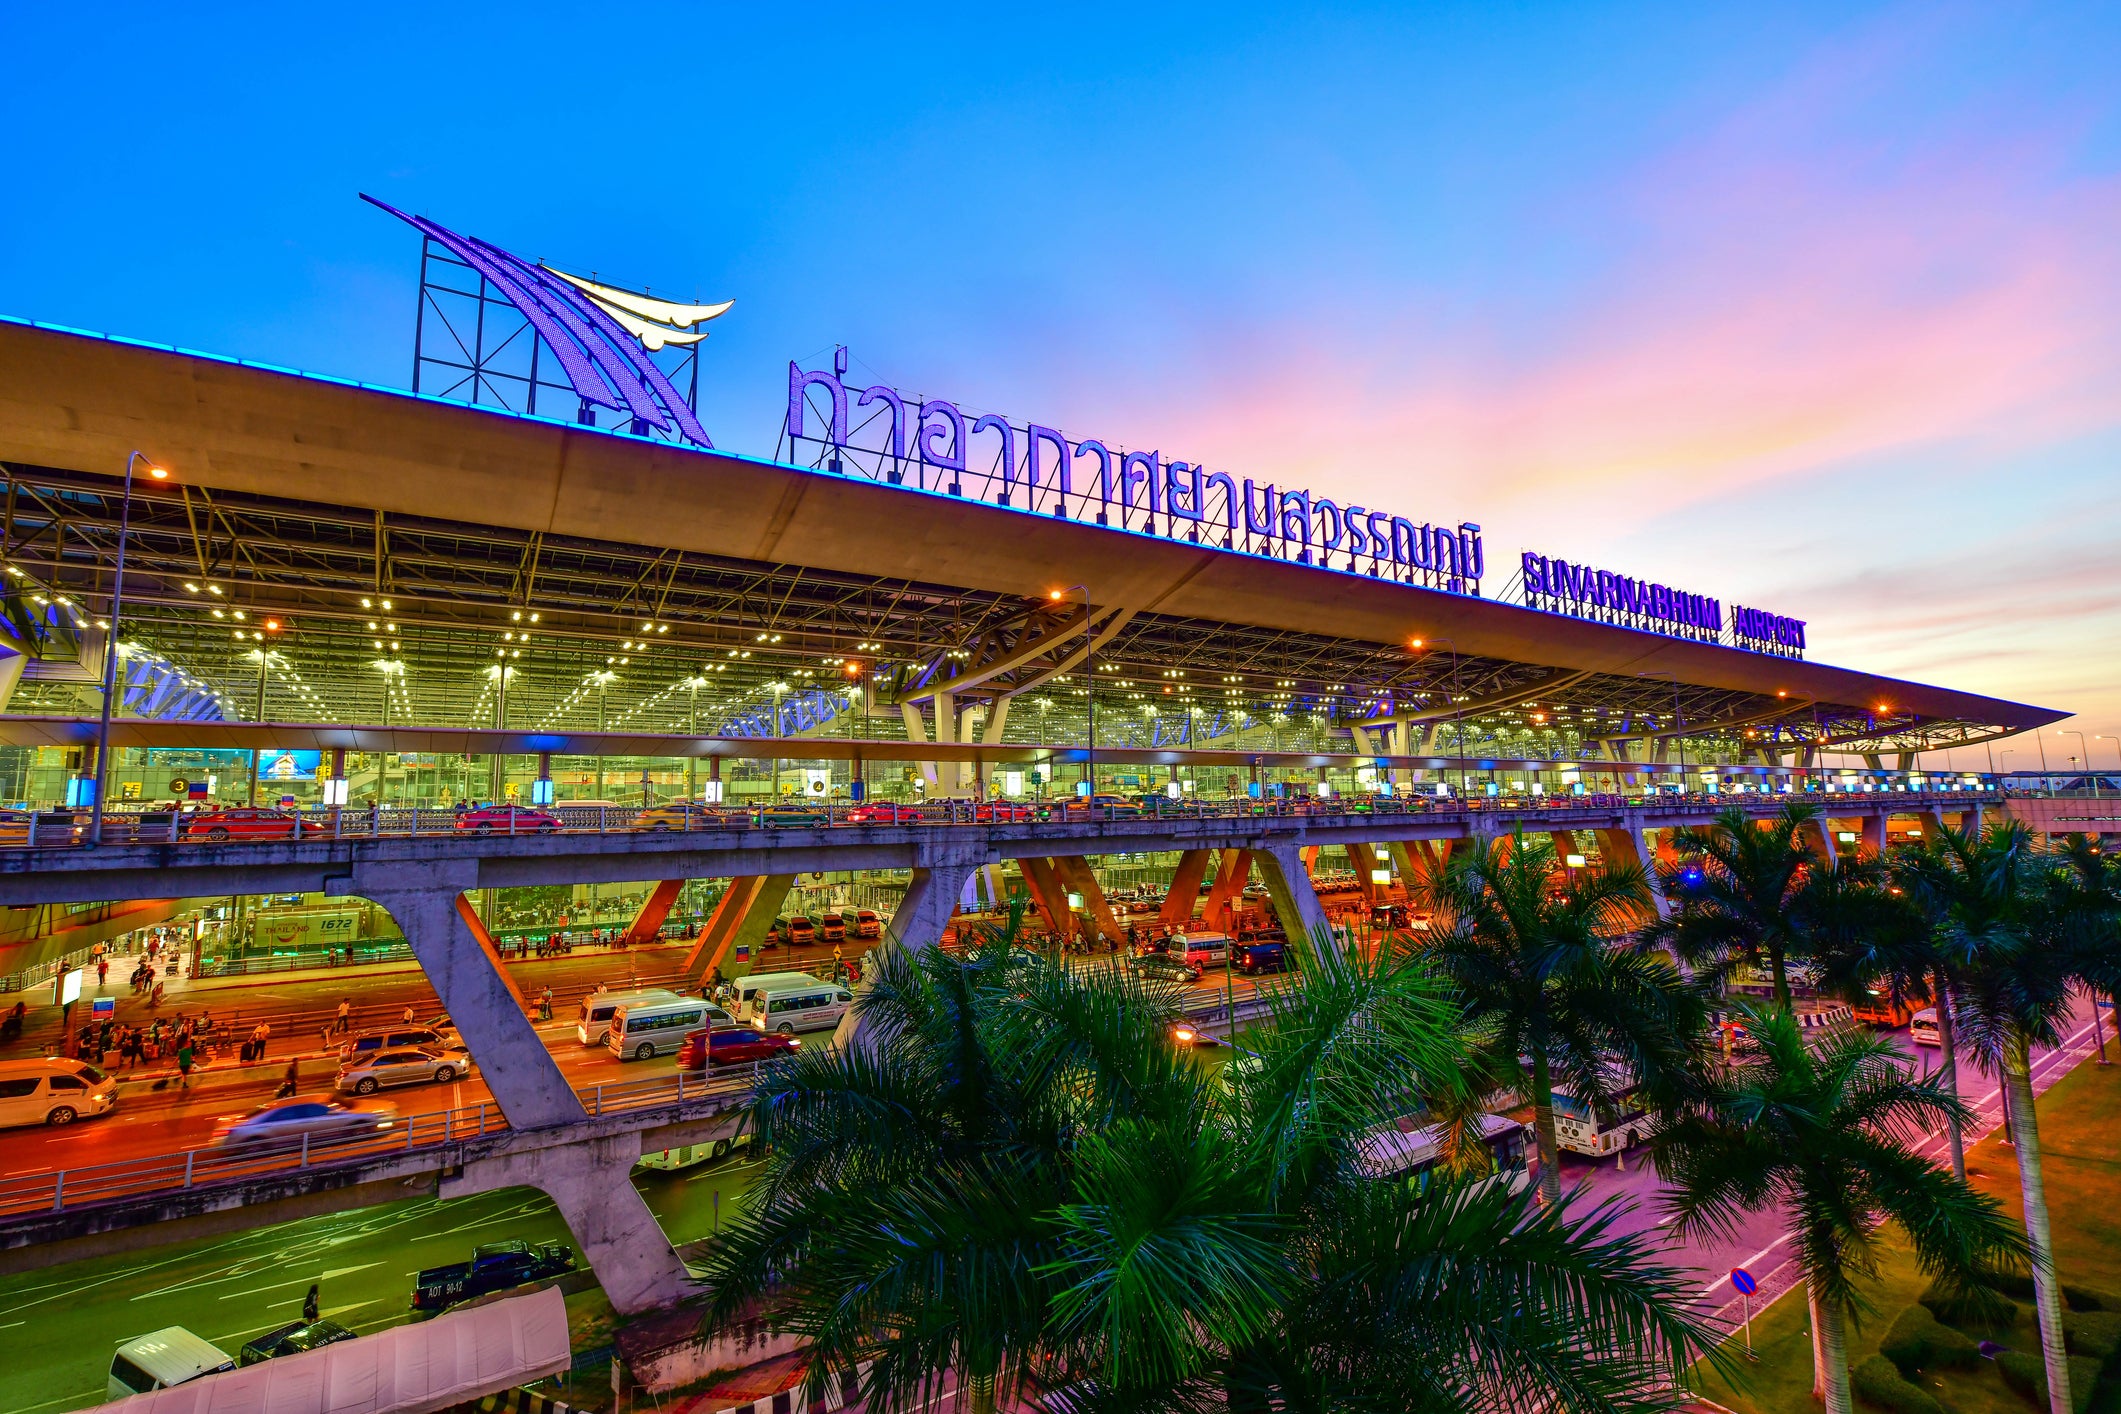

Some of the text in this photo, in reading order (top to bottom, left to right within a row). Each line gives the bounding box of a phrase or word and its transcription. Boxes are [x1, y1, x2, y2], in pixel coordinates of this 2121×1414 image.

[788, 346, 1484, 593] ท่าอากาศยานสุวรรณภูมิ
[1523, 551, 1807, 649] SUVARNABHUMI AIRPORT
[175, 781, 185, 791] 3
[264, 925, 310, 935] THAILAND
[321, 919, 353, 929] 1672
[428, 1280, 463, 1298] AOT 90-12
